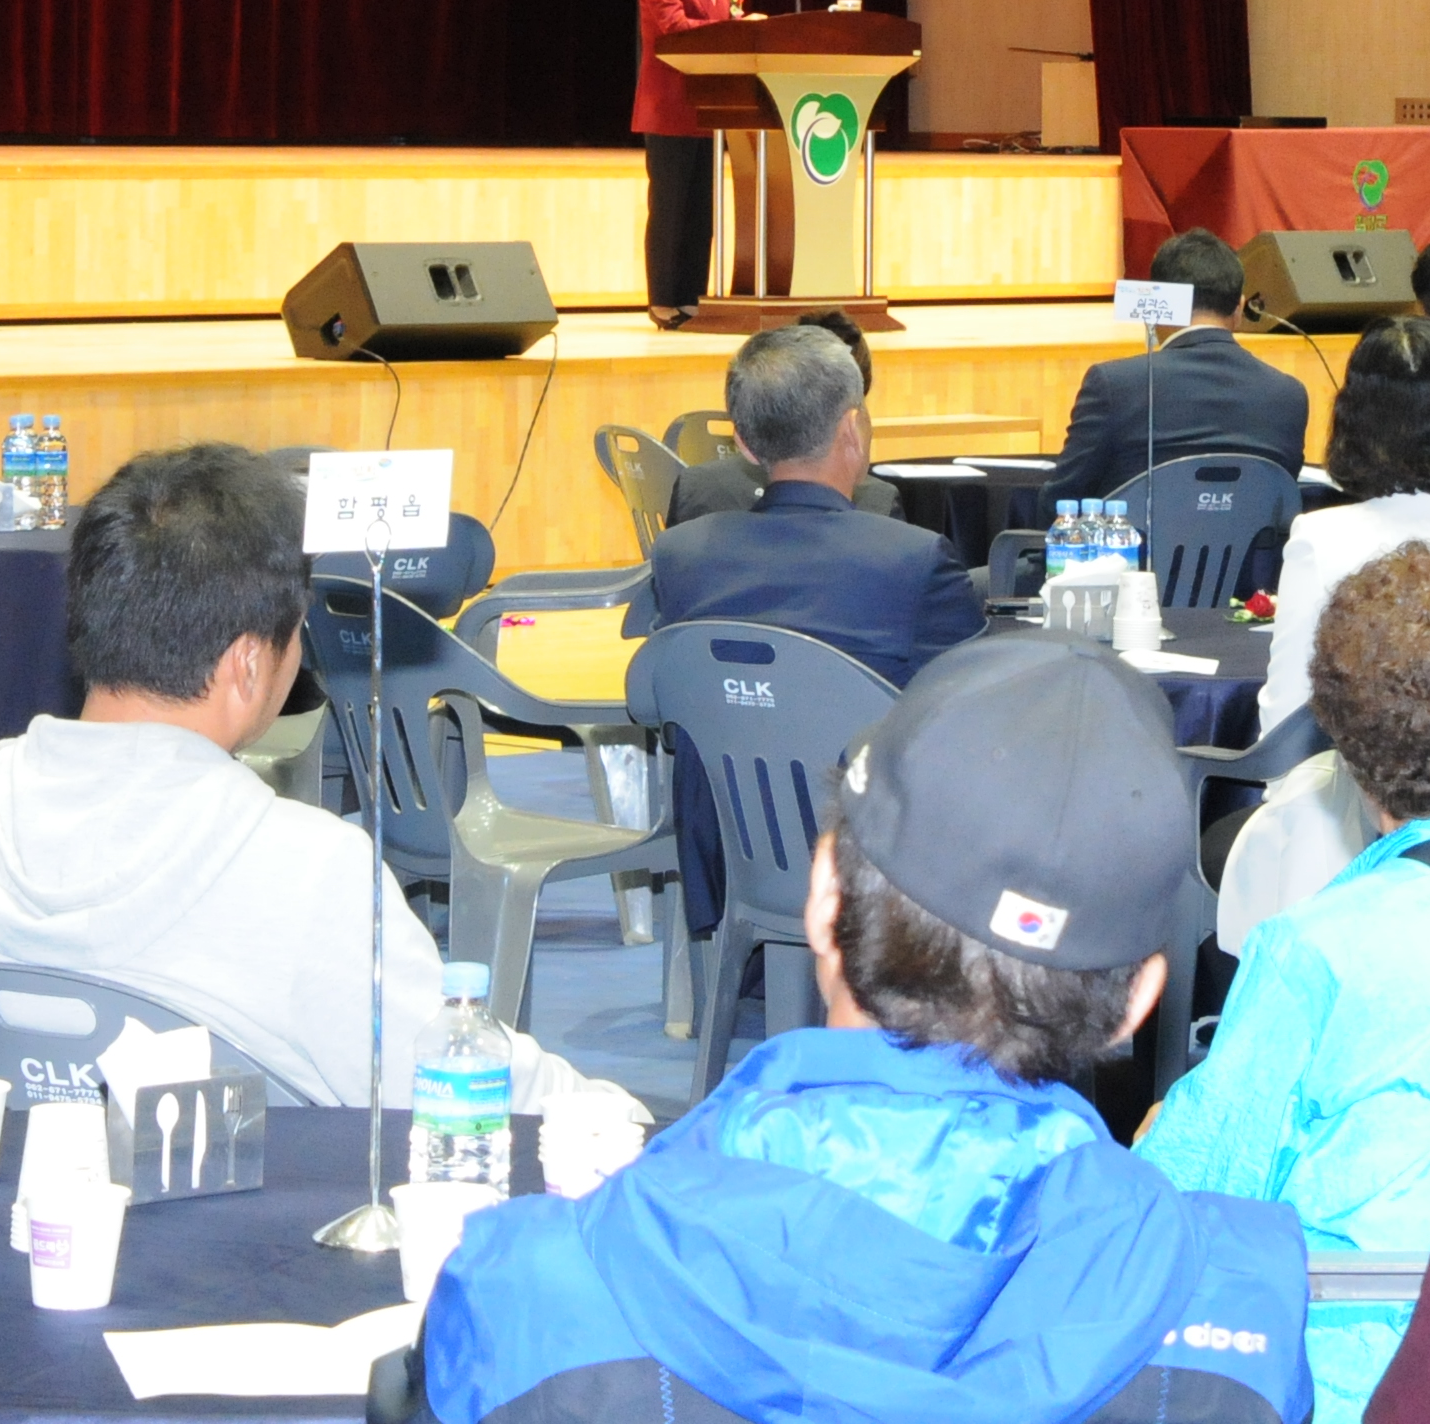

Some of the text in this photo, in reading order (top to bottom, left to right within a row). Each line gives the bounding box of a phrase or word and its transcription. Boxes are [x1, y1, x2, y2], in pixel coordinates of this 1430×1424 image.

[1199, 492, 1234, 504] CLK
[337, 494, 421, 521] 함평읍
[394, 556, 430, 571] CLK
[340, 629, 373, 645] CLK
[723, 678, 774, 697] CLK
[20, 1057, 99, 1088] CLK
